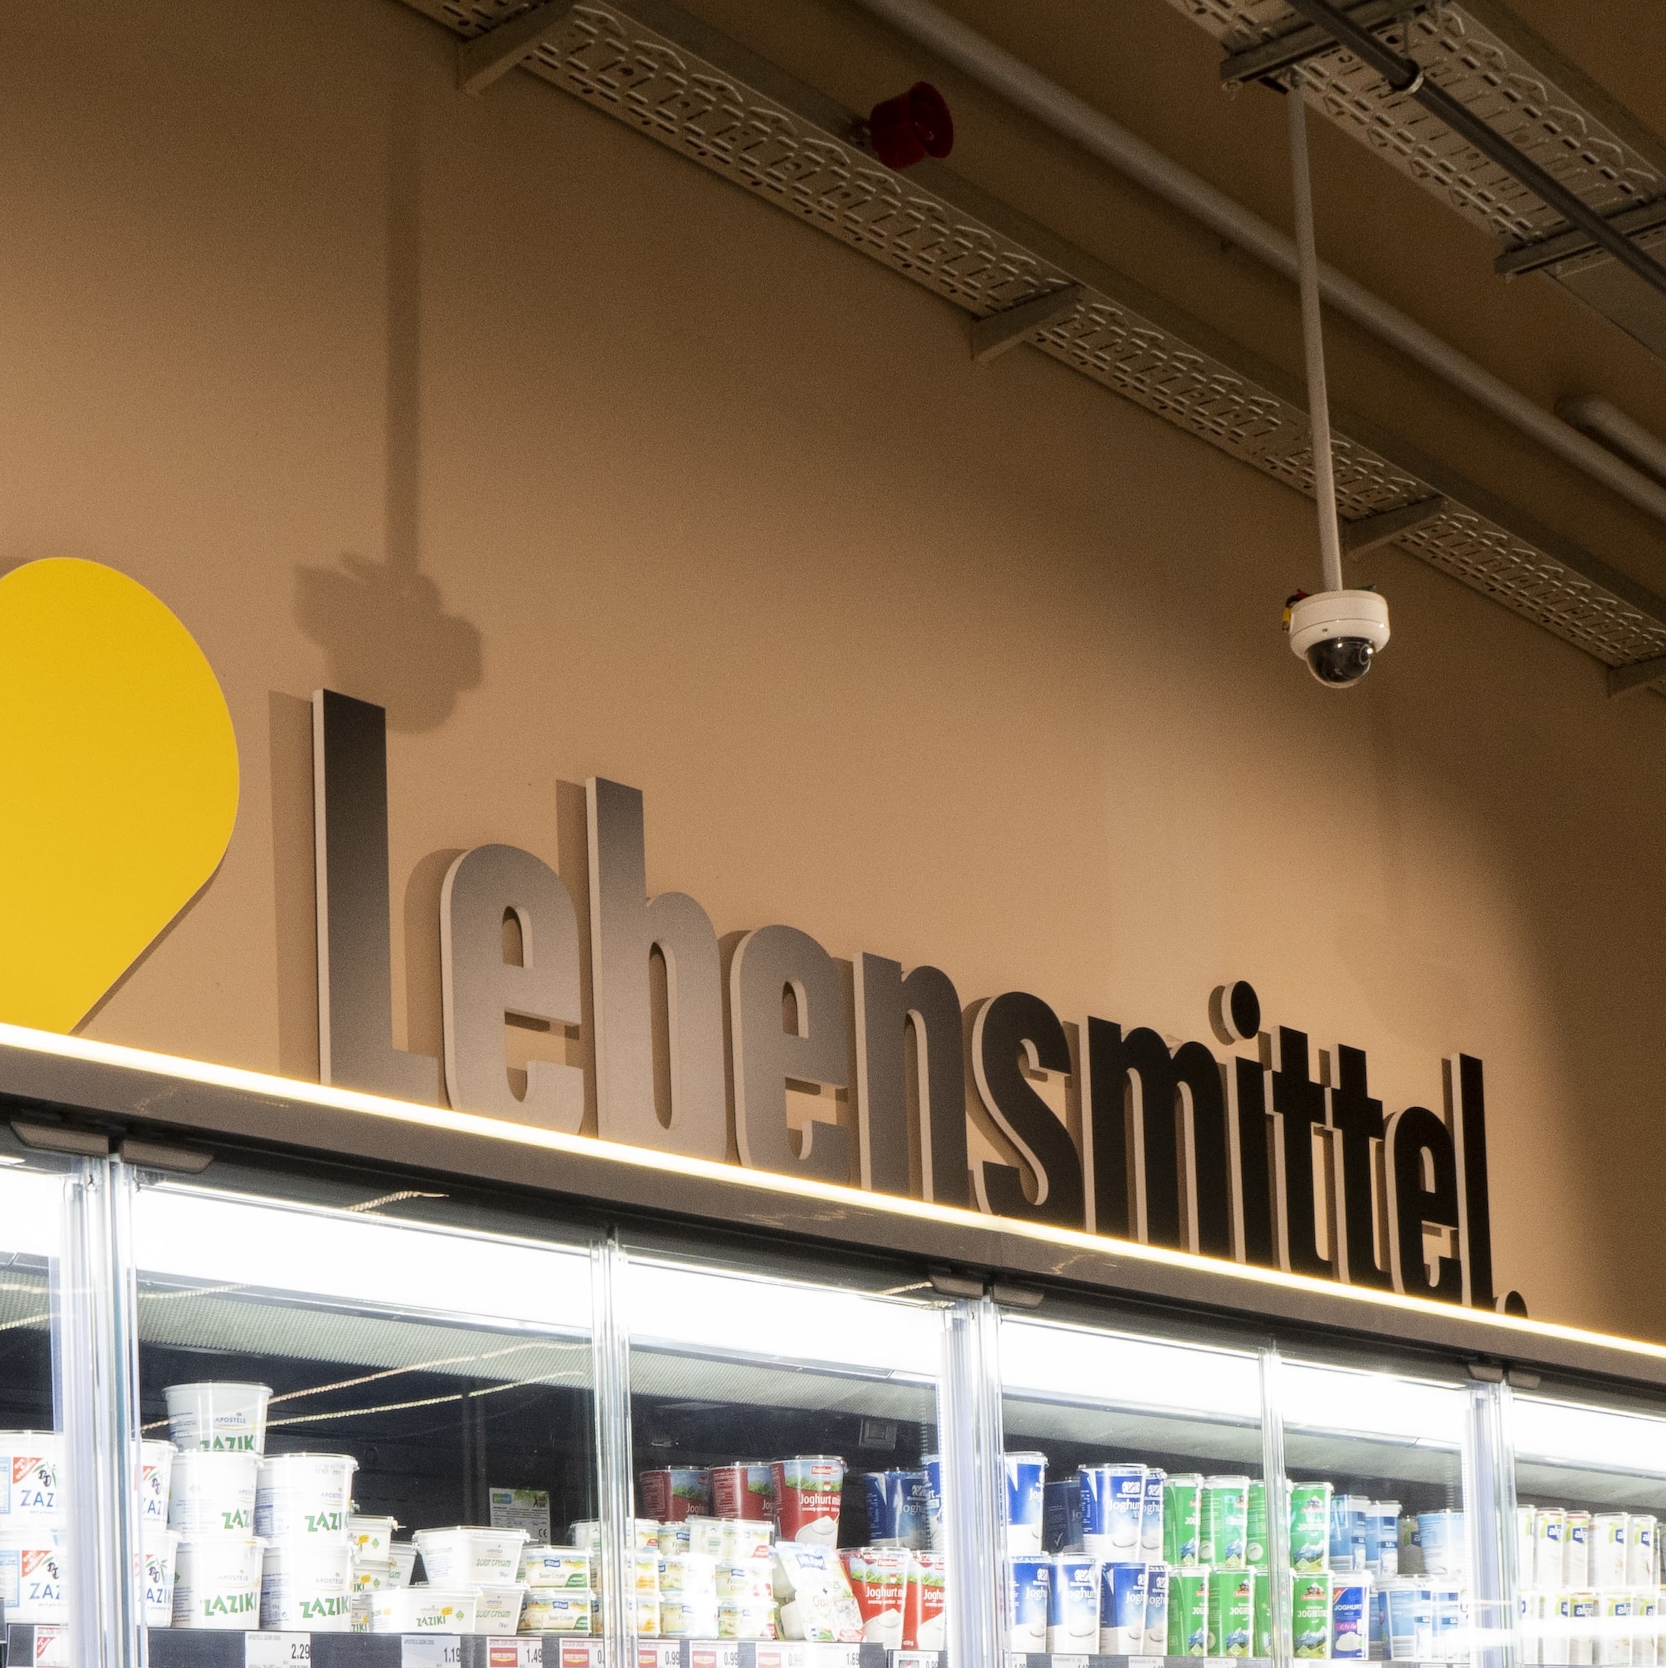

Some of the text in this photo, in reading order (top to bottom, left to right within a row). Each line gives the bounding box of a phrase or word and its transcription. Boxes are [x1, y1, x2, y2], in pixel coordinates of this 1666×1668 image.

[313, 687, 1528, 1317] Lebensmittel.
[800, 1493, 832, 1506] Joghurt
[865, 1586, 898, 1600] Joghurt
[417, 1613, 446, 1627] ZAZIKI
[291, 1643, 311, 1661] 2.29
[526, 1646, 543, 1664] 1.49
